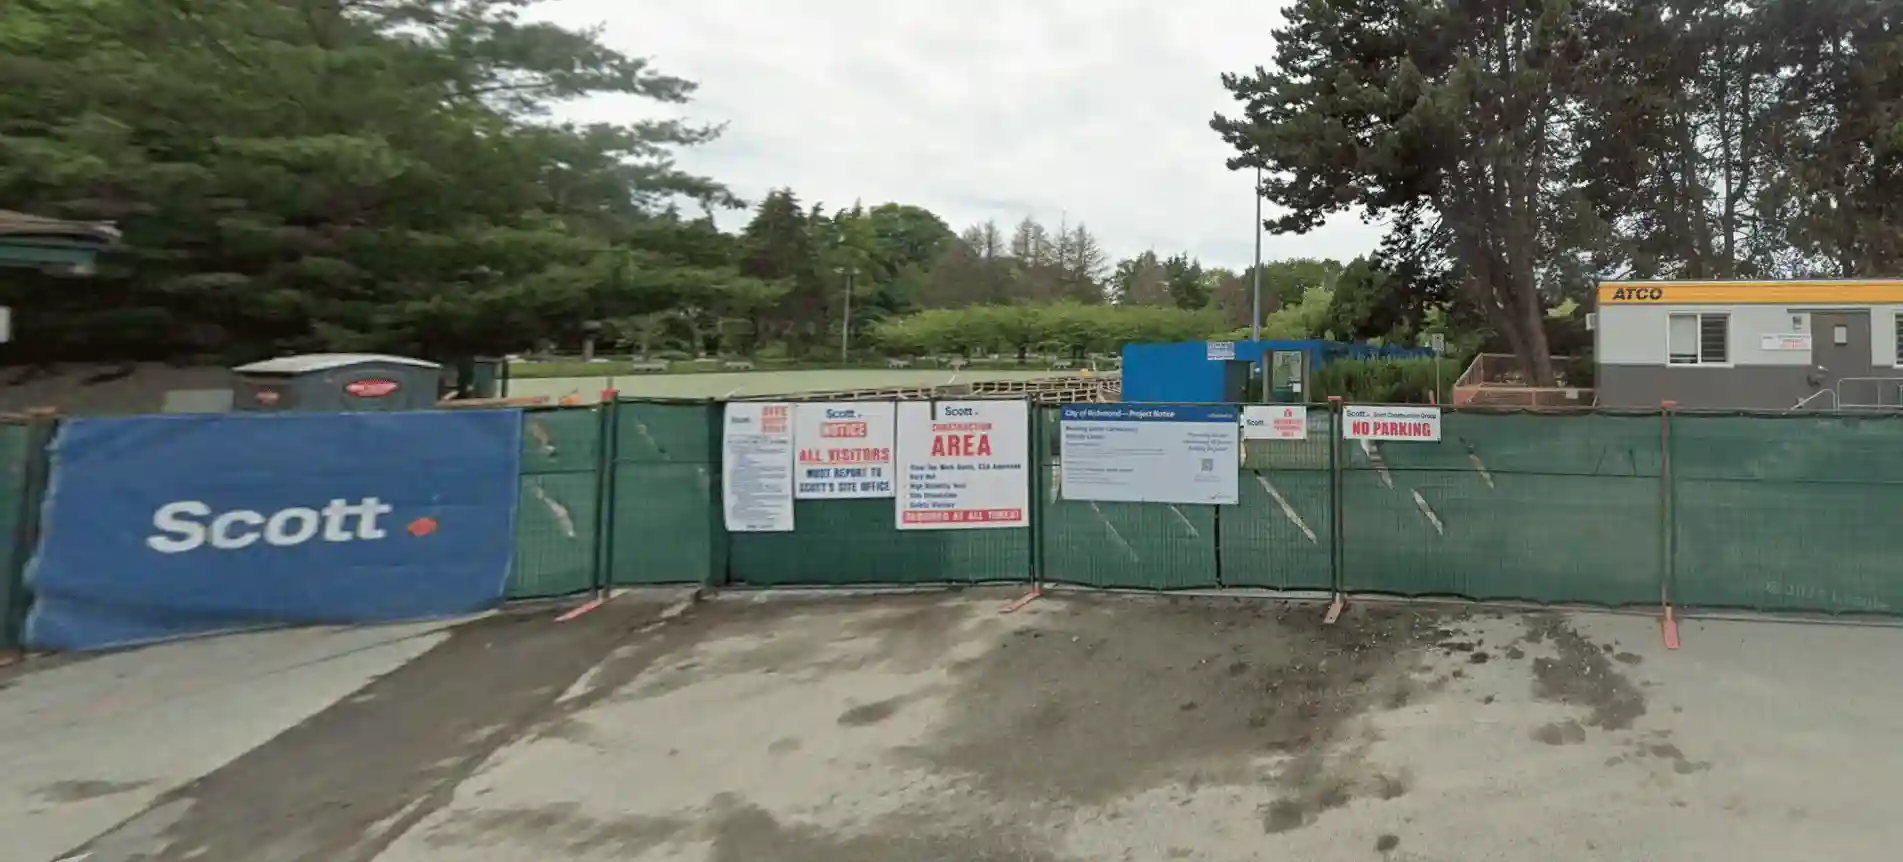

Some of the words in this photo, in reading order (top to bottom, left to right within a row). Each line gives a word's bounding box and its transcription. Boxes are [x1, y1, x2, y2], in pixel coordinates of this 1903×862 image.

[1612, 287, 1663, 301] ATCO
[826, 408, 856, 418] Scott
[945, 406, 972, 416] Scott
[823, 424, 866, 437] NOTICE
[1352, 421, 1369, 435] NO
[1373, 421, 1431, 436] PARKING
[932, 433, 992, 456] AREA
[799, 448, 821, 461] ALL
[828, 447, 889, 461] VISITORS
[834, 468, 867, 478] REPORT
[871, 467, 882, 477] TO
[147, 497, 391, 553] Scott
